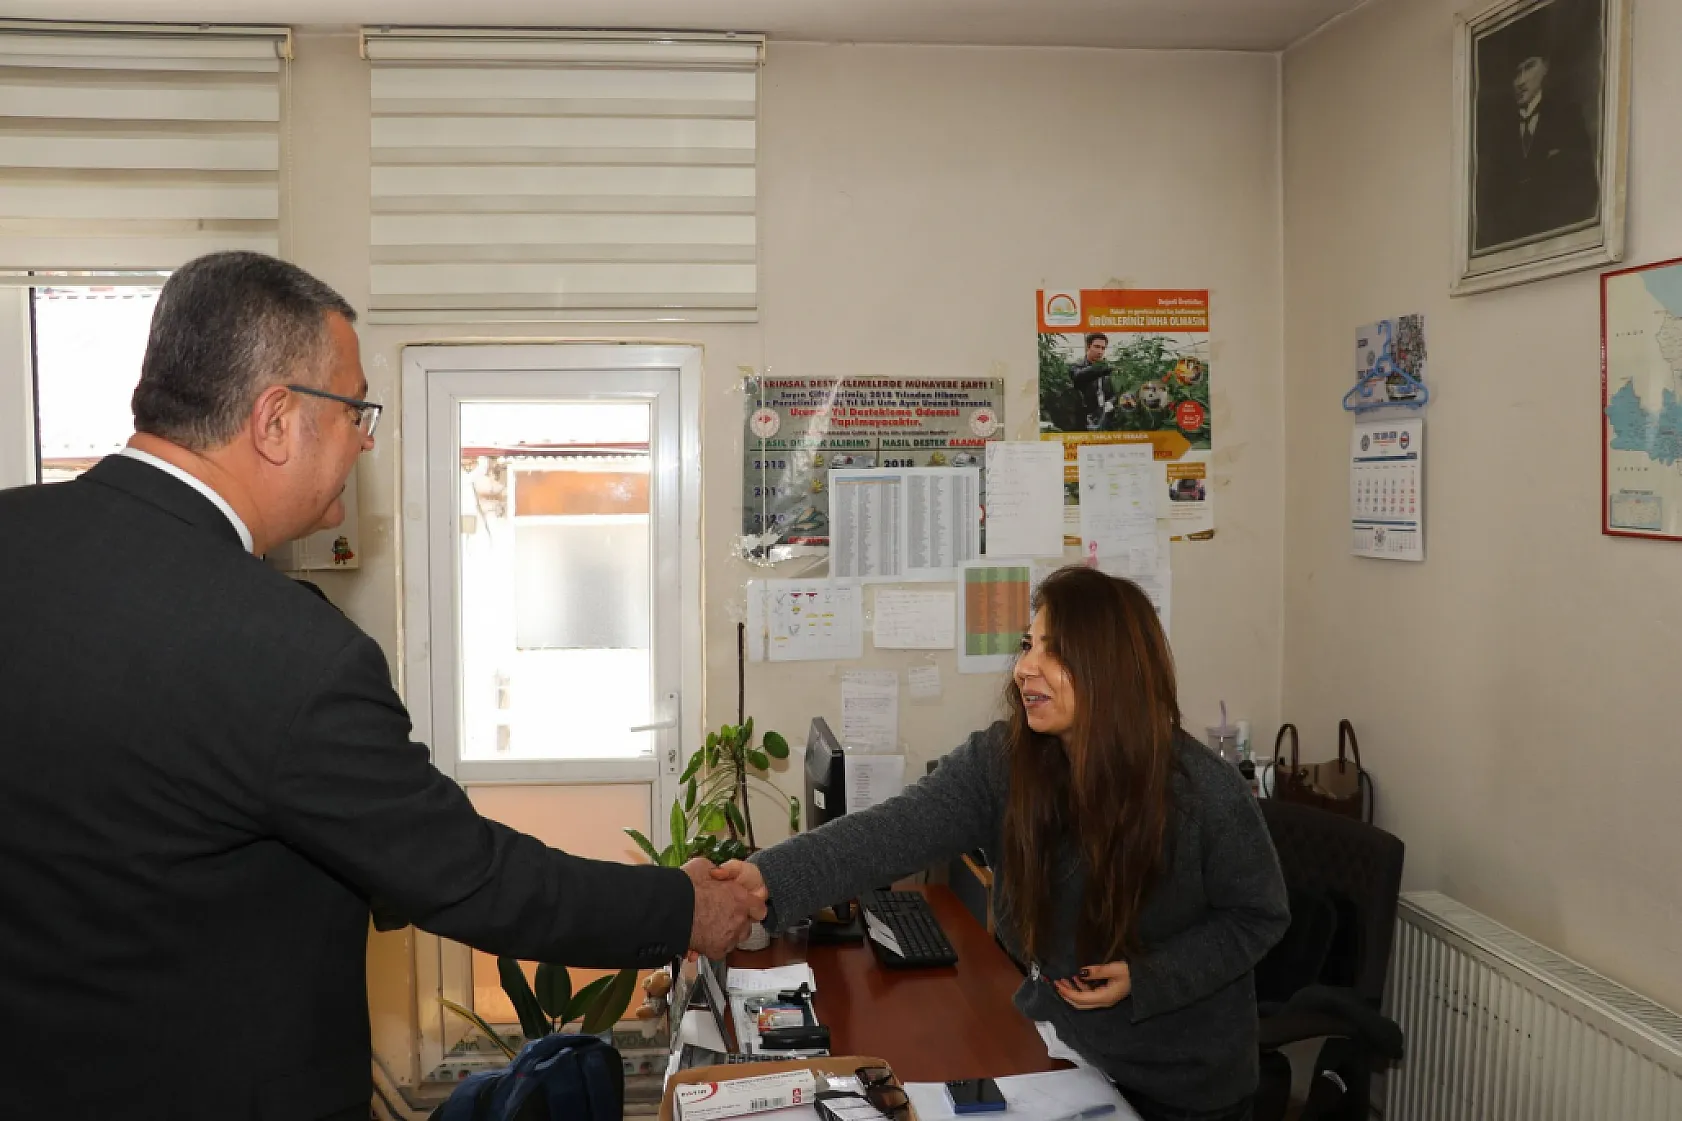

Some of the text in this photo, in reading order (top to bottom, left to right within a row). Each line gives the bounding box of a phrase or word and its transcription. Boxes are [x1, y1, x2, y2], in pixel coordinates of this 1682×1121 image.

[882, 439, 910, 447] NASIL
[913, 439, 946, 447] DESTEK
[883, 458, 913, 468] 2018
